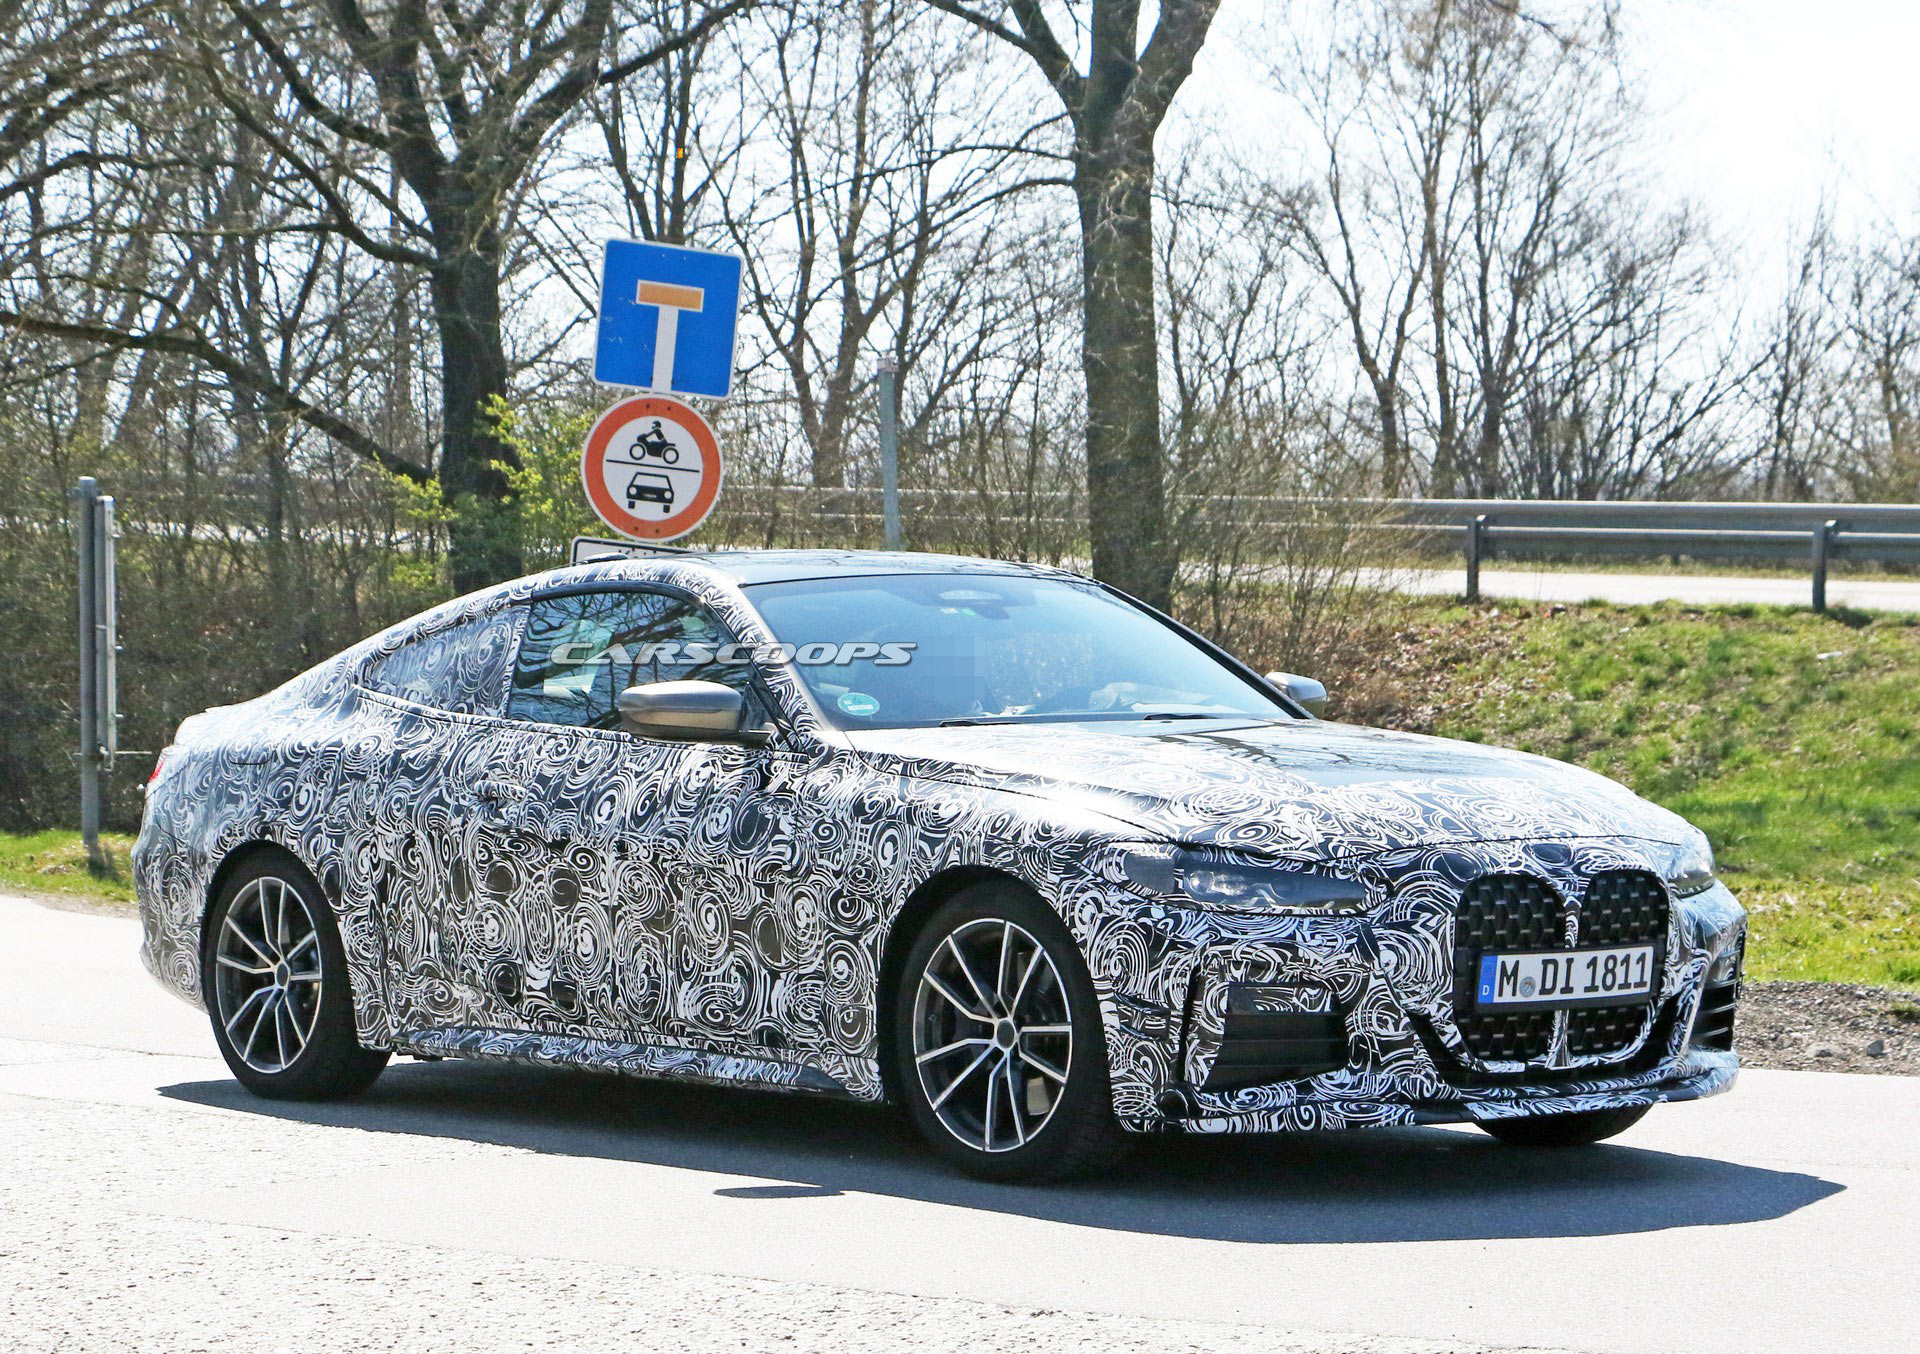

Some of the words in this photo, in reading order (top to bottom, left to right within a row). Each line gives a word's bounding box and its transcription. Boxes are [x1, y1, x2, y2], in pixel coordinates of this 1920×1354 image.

[1498, 959, 1520, 997] M
[1538, 957, 1575, 996] DI
[1583, 952, 1648, 993] 1811
[1482, 984, 1490, 996] D
